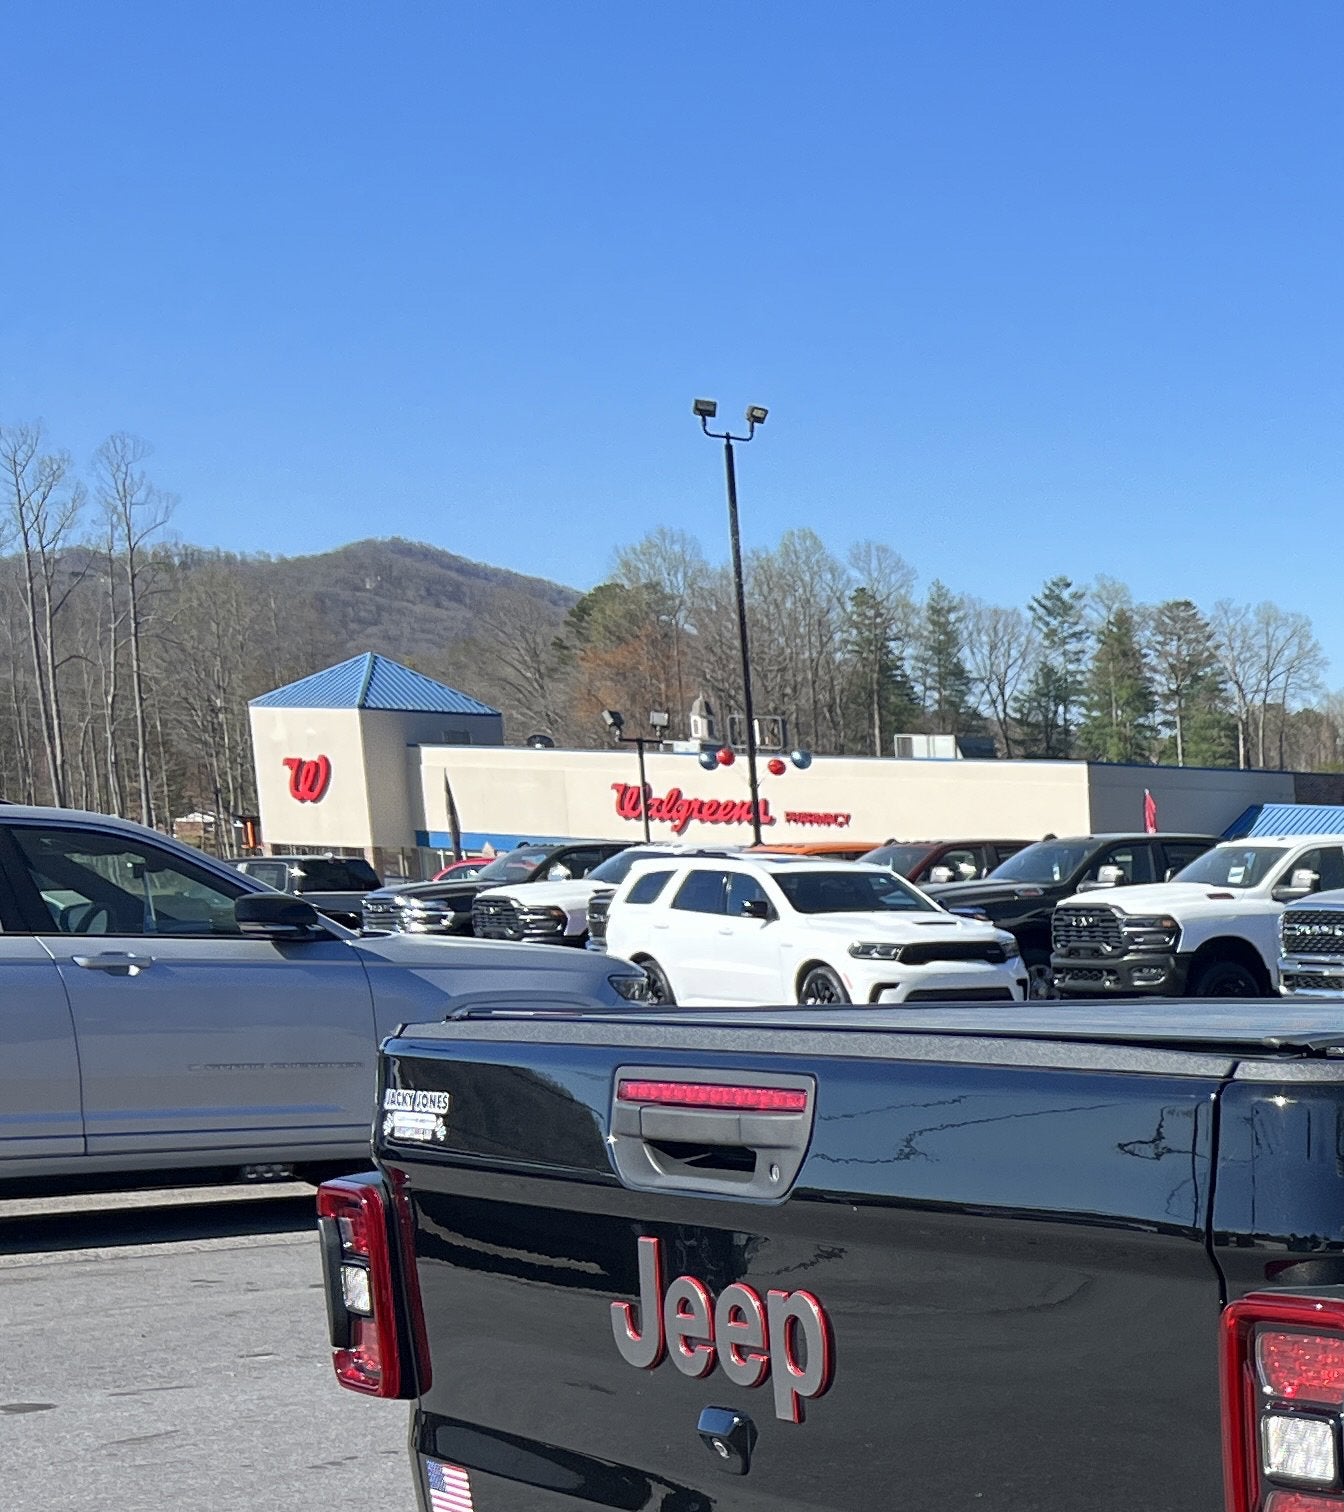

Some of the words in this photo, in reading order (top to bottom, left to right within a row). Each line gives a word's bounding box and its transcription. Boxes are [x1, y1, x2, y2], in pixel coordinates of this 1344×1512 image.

[385, 1090, 414, 1107] JACKY
[415, 1092, 449, 1110] JONES
[610, 1236, 838, 1425] Jeep
